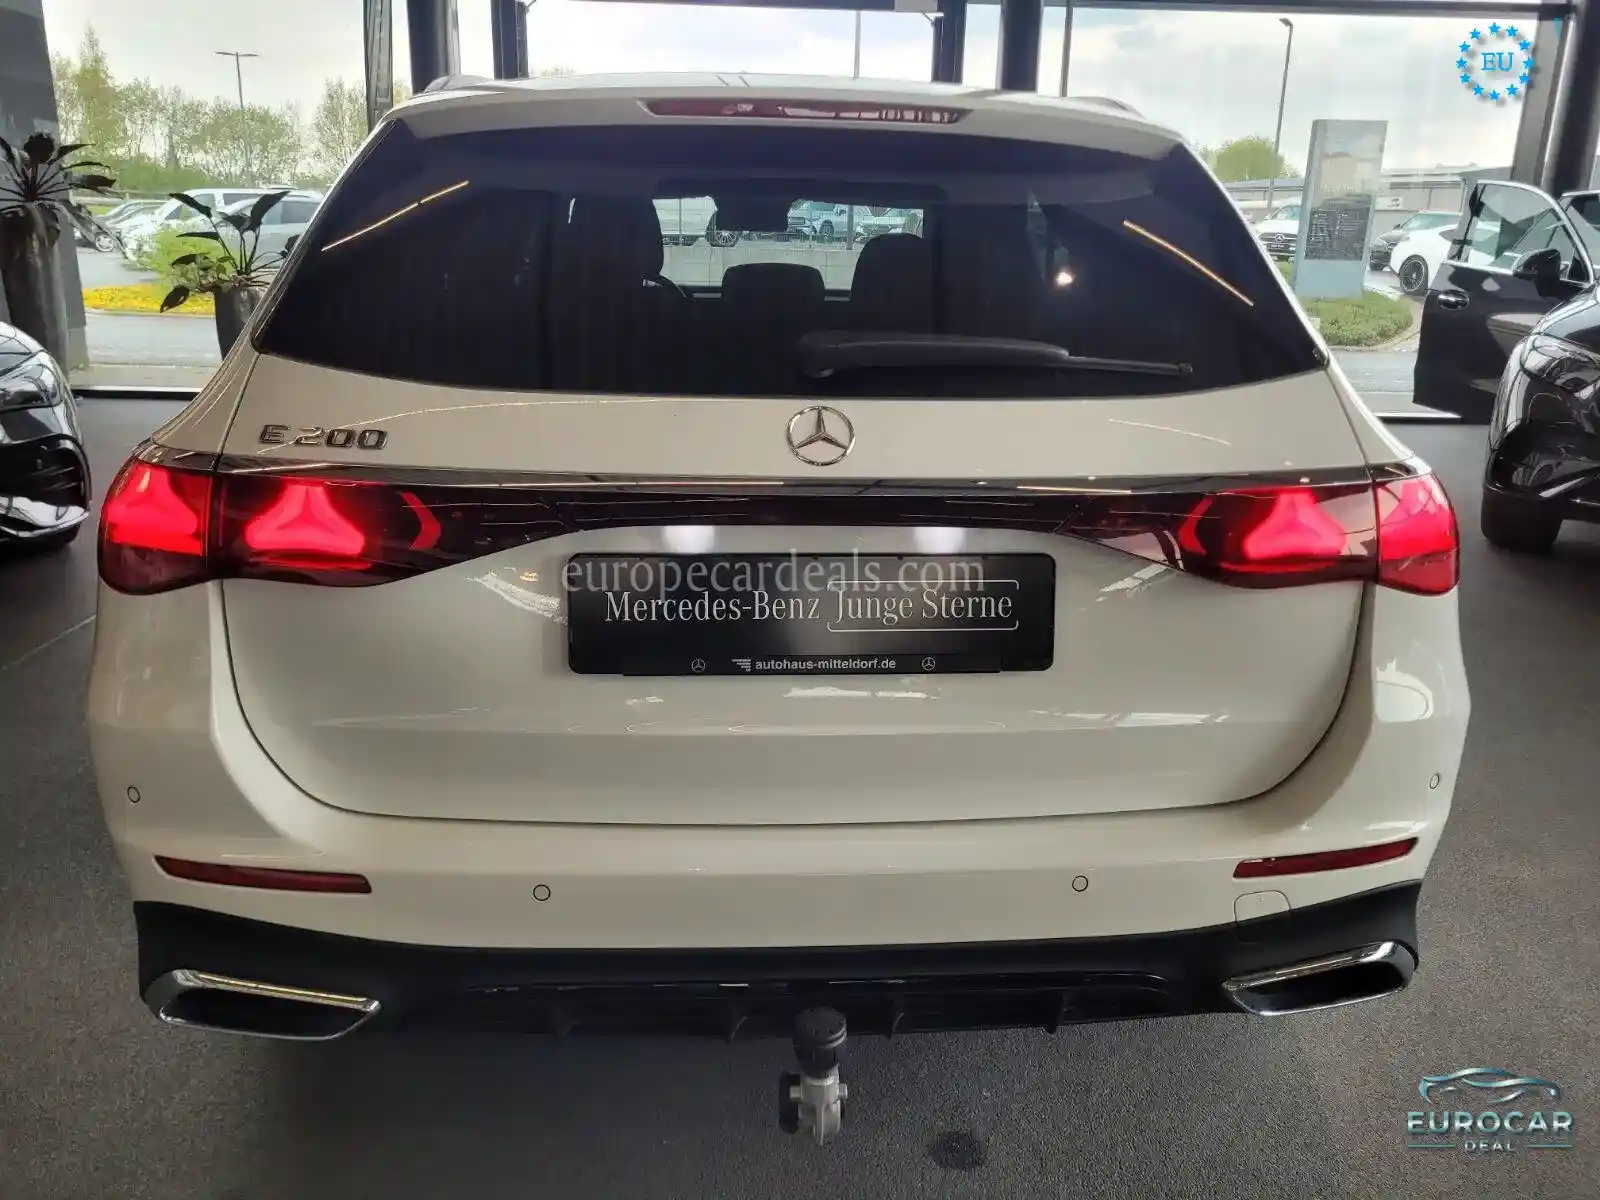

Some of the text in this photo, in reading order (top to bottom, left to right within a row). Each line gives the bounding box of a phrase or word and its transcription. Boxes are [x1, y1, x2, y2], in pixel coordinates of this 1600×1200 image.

[258, 424, 389, 450] E 200
[604, 588, 1013, 626] Mercedes-Benz Junge Sterne
[755, 657, 897, 671] autohaus-mitteldorf.de
